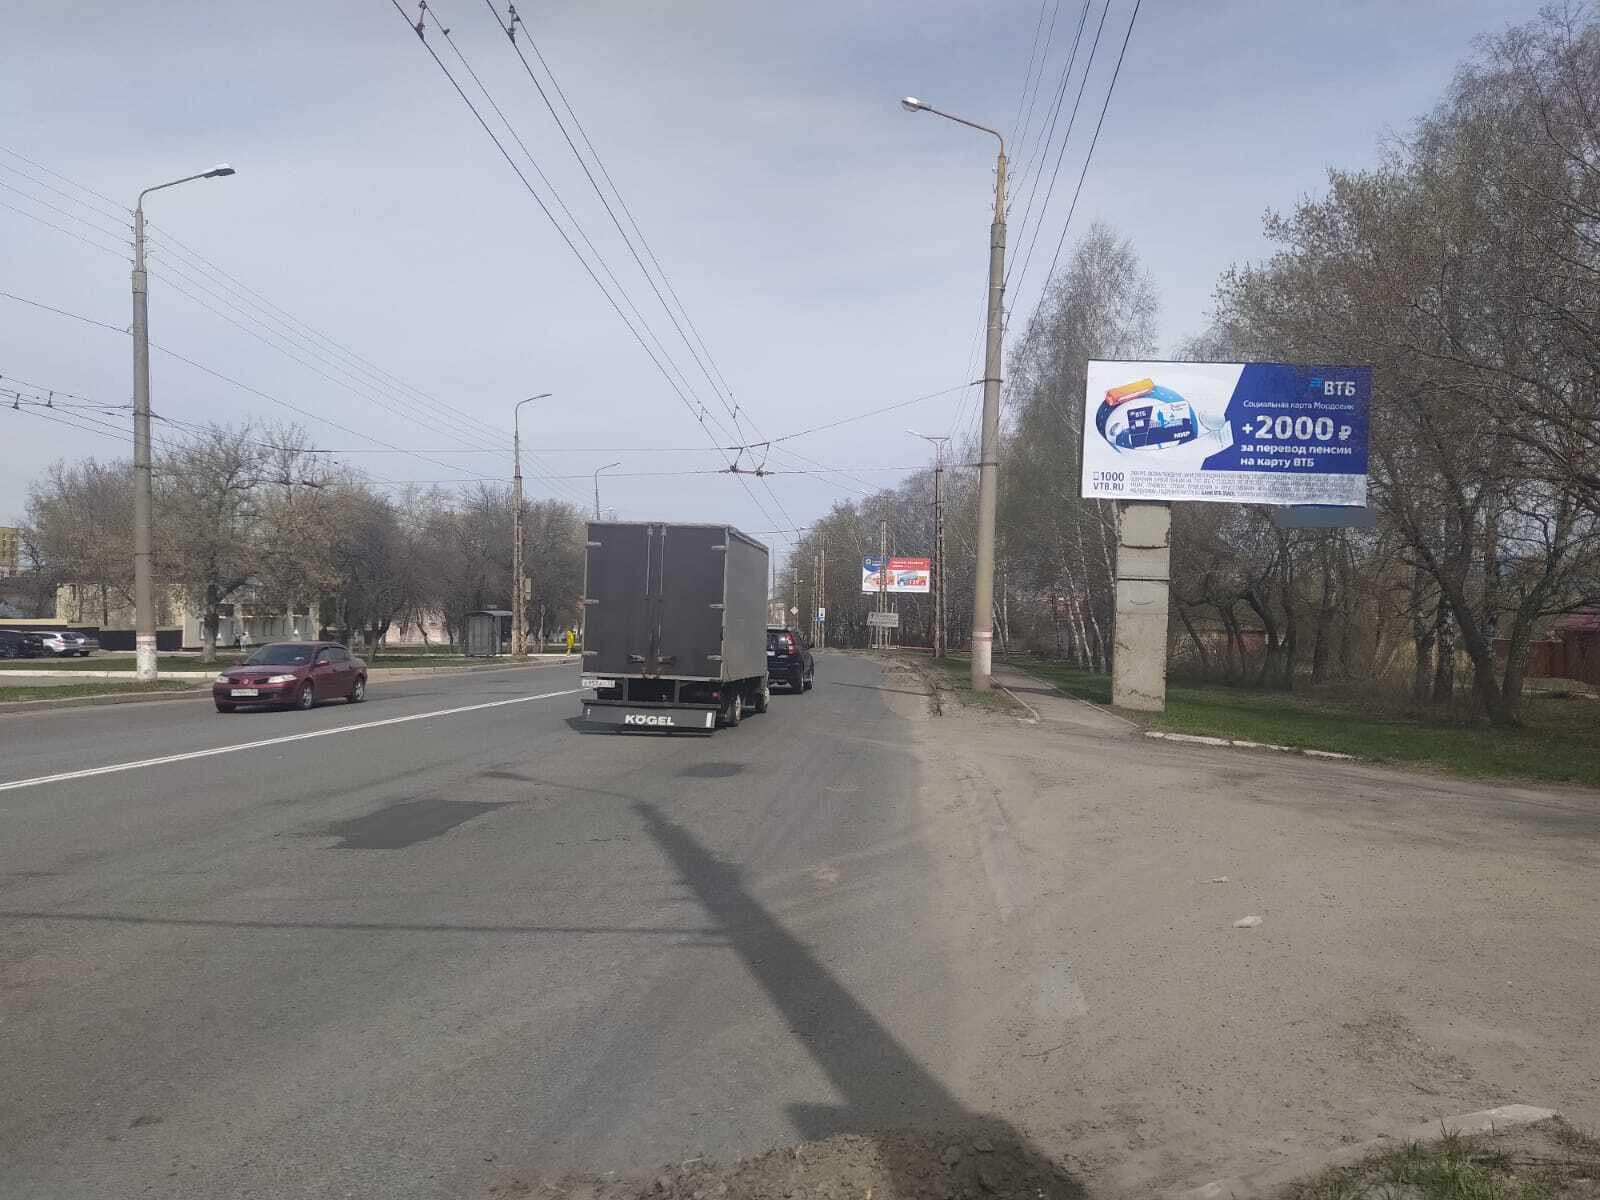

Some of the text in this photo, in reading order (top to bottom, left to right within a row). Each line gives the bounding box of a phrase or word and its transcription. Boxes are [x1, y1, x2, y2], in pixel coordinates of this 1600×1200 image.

[1323, 380, 1356, 397] ВТБ
[1243, 399, 1289, 411] Социальная
[1291, 402, 1312, 411] карта
[1242, 415, 1334, 441] +2000
[1240, 444, 1352, 455] за перевод пенсии
[1240, 458, 1315, 468] на карту ВТБ
[1100, 472, 1125, 482] 1000
[1093, 482, 1124, 491] VTB.RU
[625, 714, 674, 726] KÖGEL
